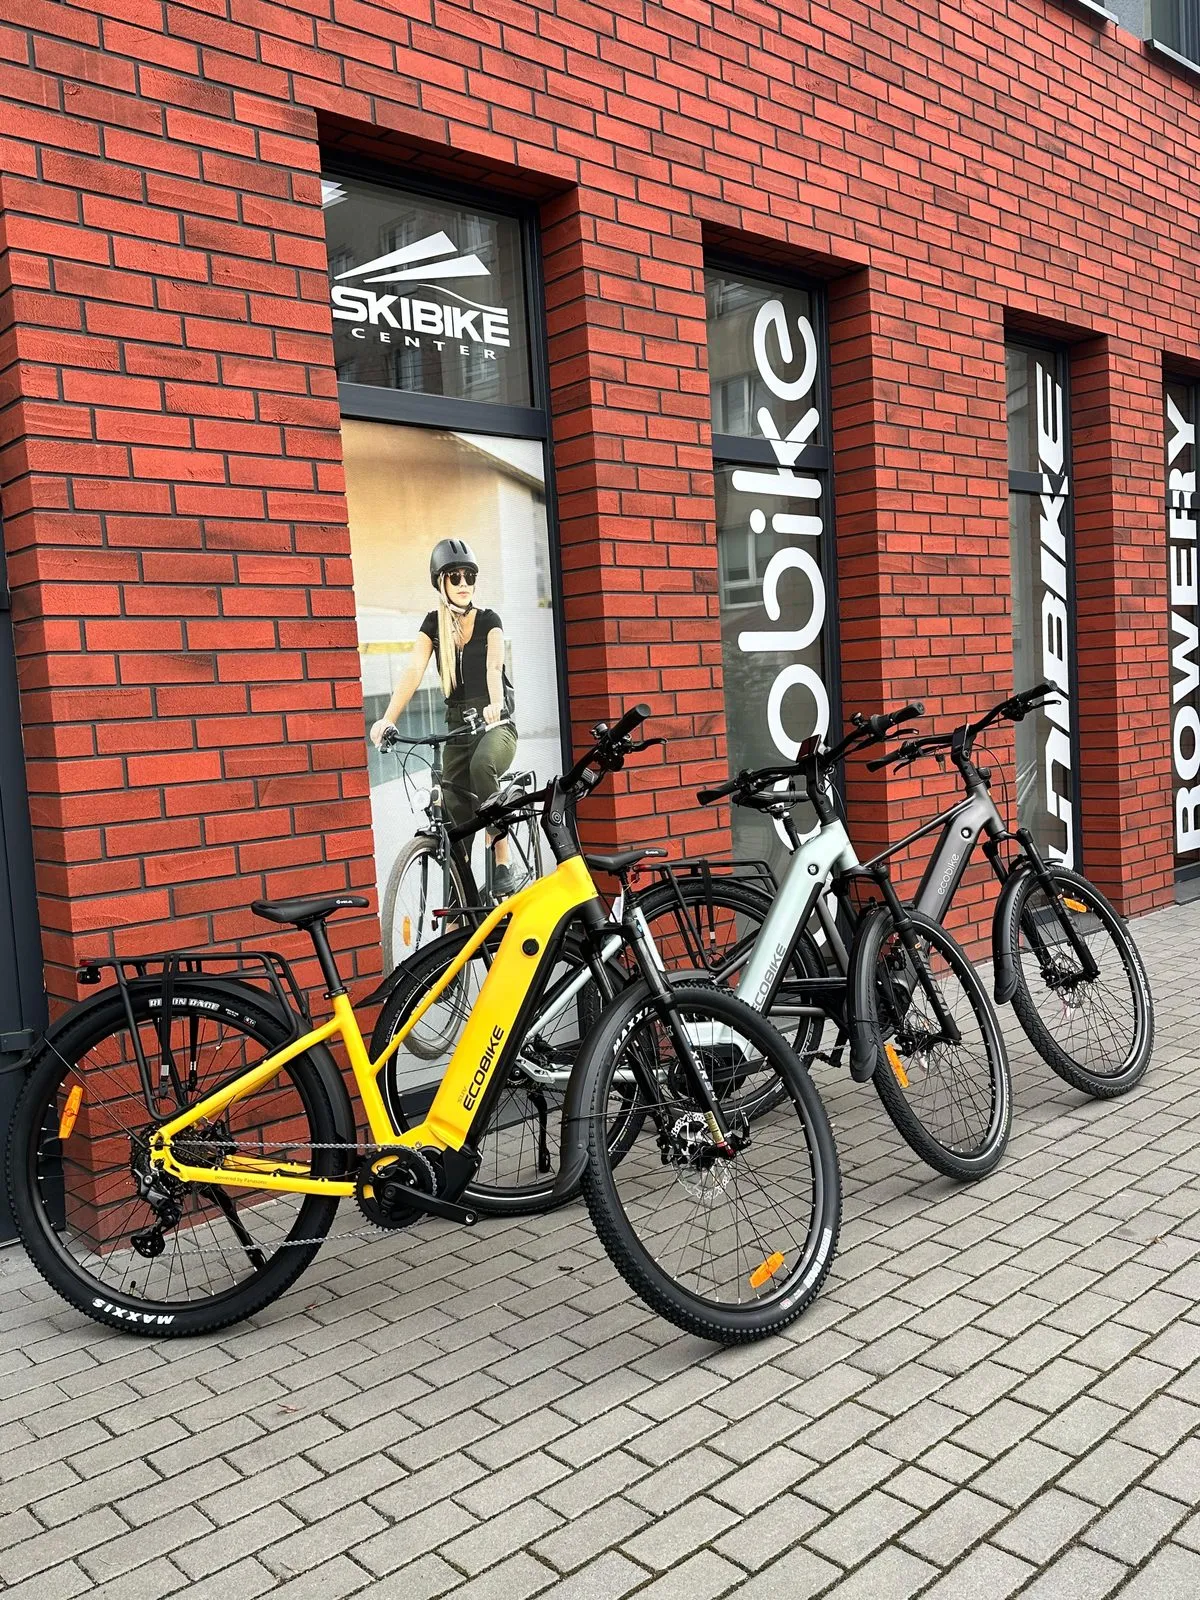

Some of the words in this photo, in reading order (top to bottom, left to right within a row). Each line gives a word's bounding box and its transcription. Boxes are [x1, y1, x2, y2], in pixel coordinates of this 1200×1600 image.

[331, 285, 511, 348] SKIBIKE
[351, 327, 497, 360] CENTER
[937, 853, 960, 895] ecobike
[612, 1006, 656, 1056] MAXXI
[462, 1024, 505, 1111] ECOBIKE
[91, 1297, 175, 1325] MAXXIS
